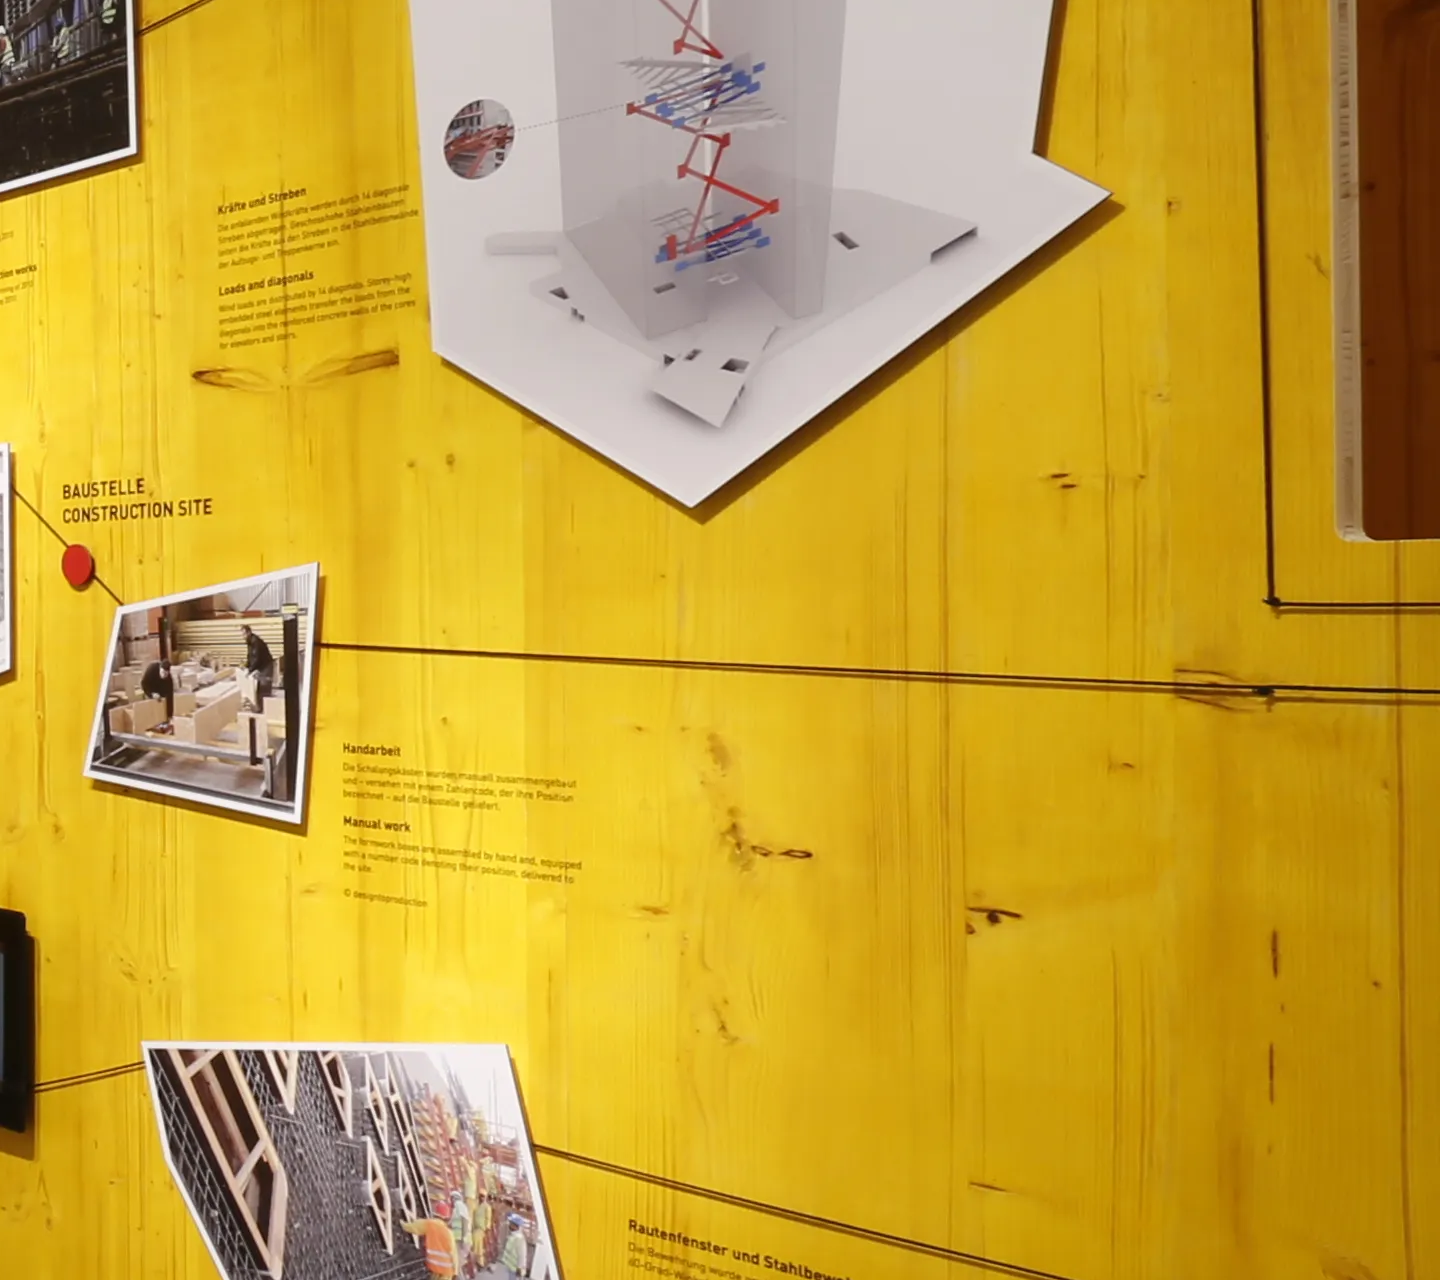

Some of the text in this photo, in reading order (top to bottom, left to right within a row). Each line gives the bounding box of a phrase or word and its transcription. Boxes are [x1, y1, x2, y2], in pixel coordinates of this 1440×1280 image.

[248, 196, 266, 208] und
[268, 188, 307, 204] Streben
[15, 264, 38, 276] works
[219, 269, 315, 297] Loads and diagonals
[63, 478, 145, 500] BAUSTELLE
[62, 498, 213, 524] CONSTRUCTION SITE
[342, 742, 402, 757] Handarbeit
[343, 815, 411, 833] Manual work
[495, 852, 518, 864] hand
[540, 858, 583, 870] equipped
[628, 1219, 729, 1257] Rautenfenster
[732, 1249, 761, 1267] und
[646, 1247, 706, 1275] Bewehrung
